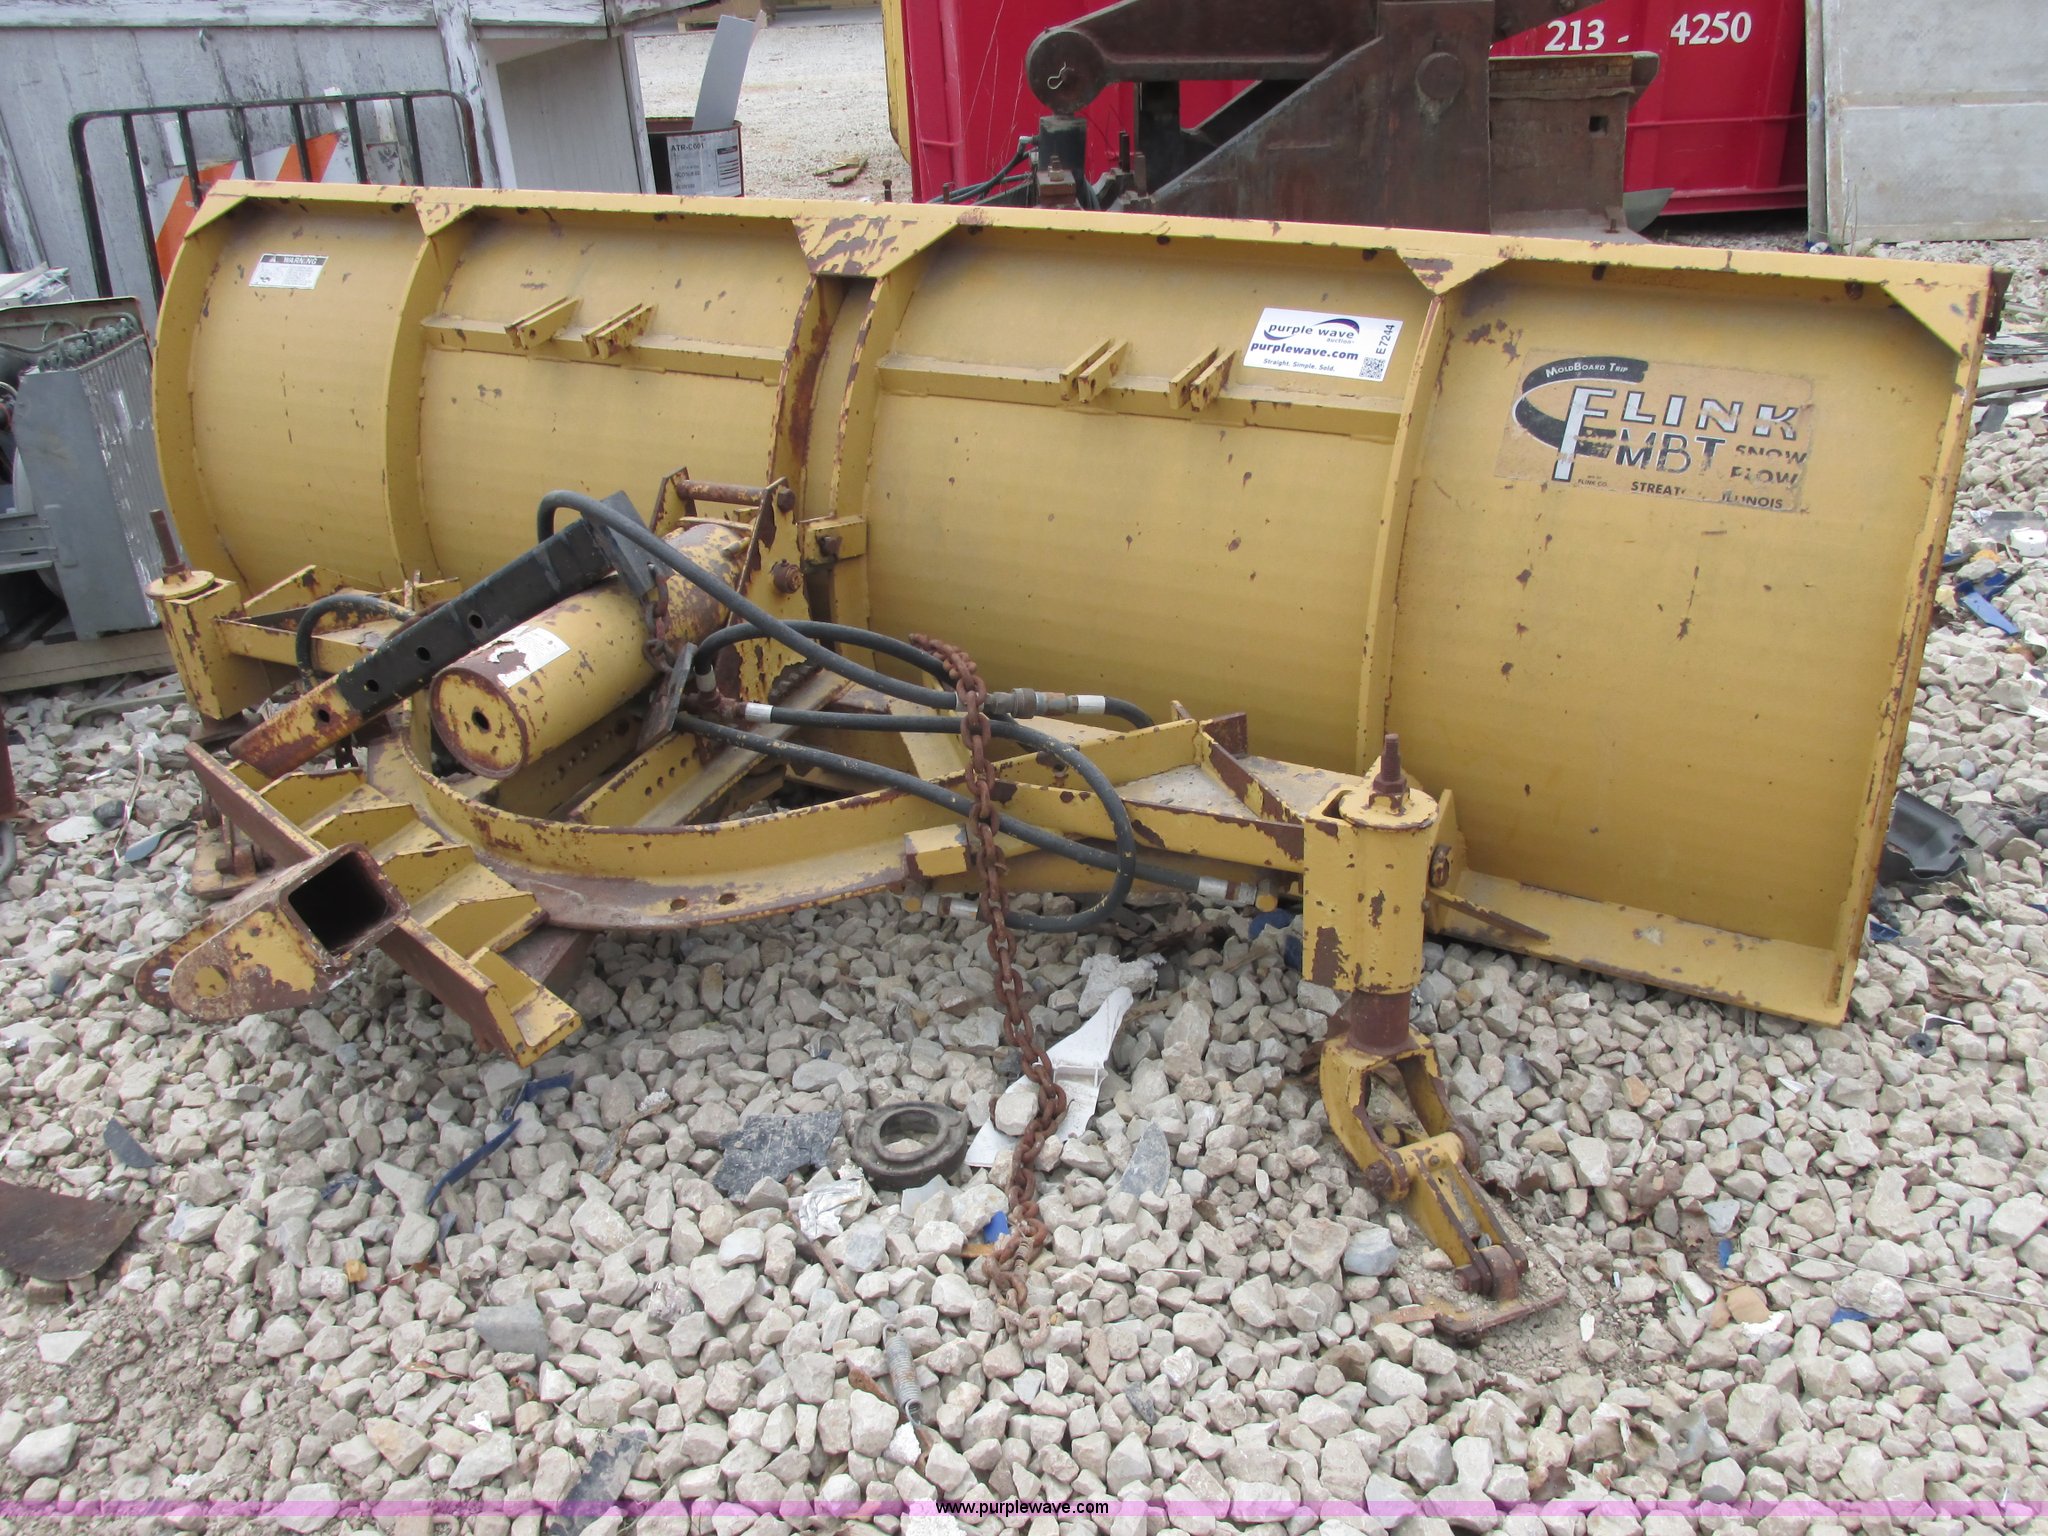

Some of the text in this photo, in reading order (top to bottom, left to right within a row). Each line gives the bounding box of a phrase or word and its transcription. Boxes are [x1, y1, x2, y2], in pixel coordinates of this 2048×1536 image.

[1544, 19, 1605, 52] 213
[1670, 11, 1752, 46] 4250
[283, 256, 318, 265] WARNNG
[1268, 323, 1355, 339] purple wave
[1250, 342, 1359, 361] purplewave.com
[1263, 358, 1336, 372] Straight. Simple. Sold.
[1552, 385, 1801, 483] FLINK
[1615, 427, 1727, 475] MBT
[1722, 492, 1784, 509] ILINOIS
